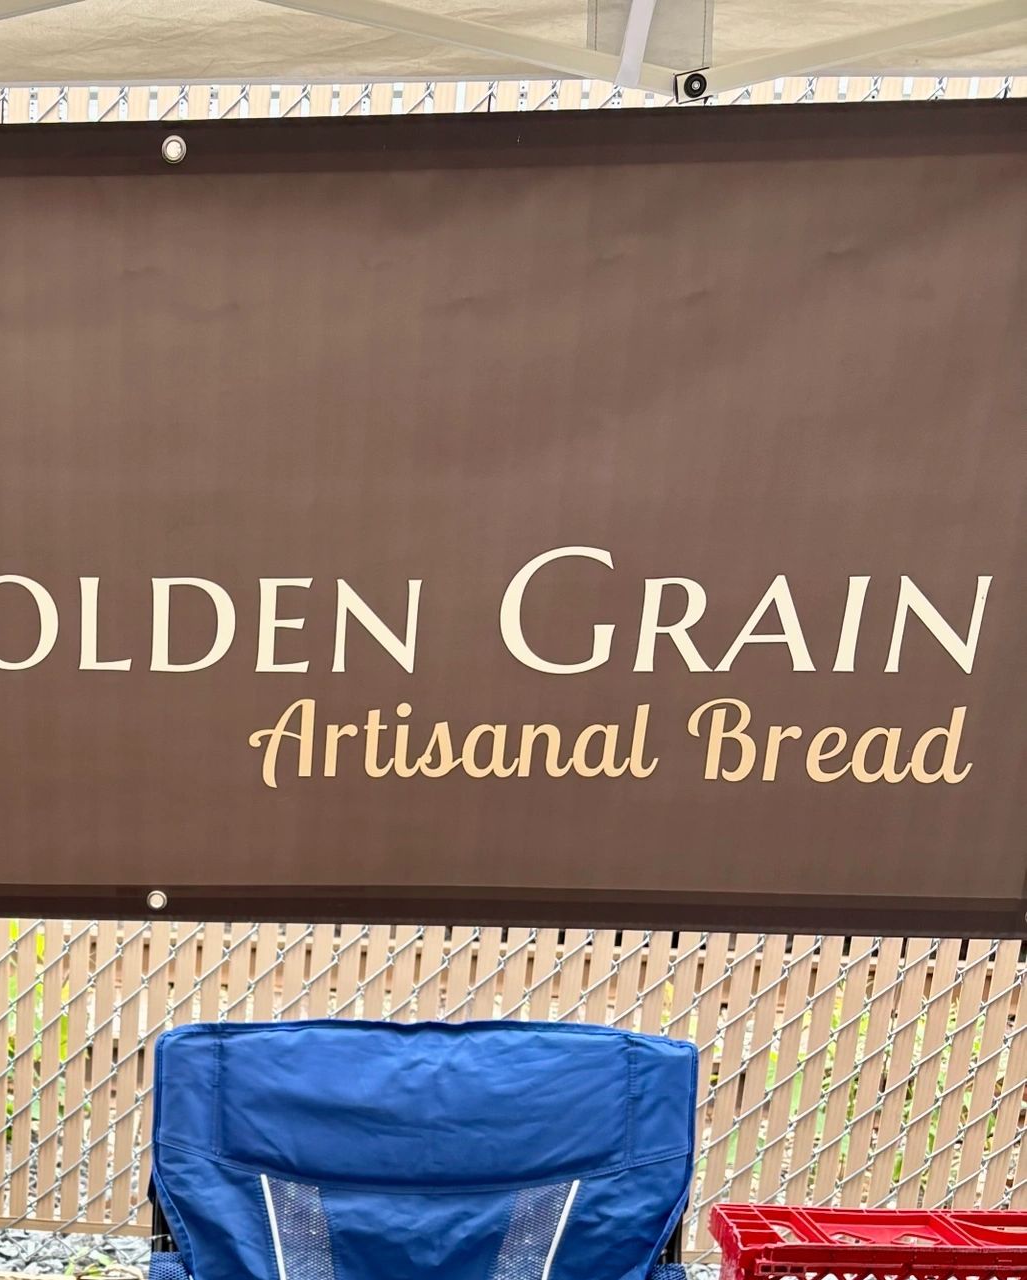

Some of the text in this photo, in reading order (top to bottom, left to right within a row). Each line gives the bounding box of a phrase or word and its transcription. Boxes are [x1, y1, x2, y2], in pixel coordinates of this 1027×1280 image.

[498, 545, 993, 674] GRAIN
[248, 697, 972, 788] Artisanal Bread
